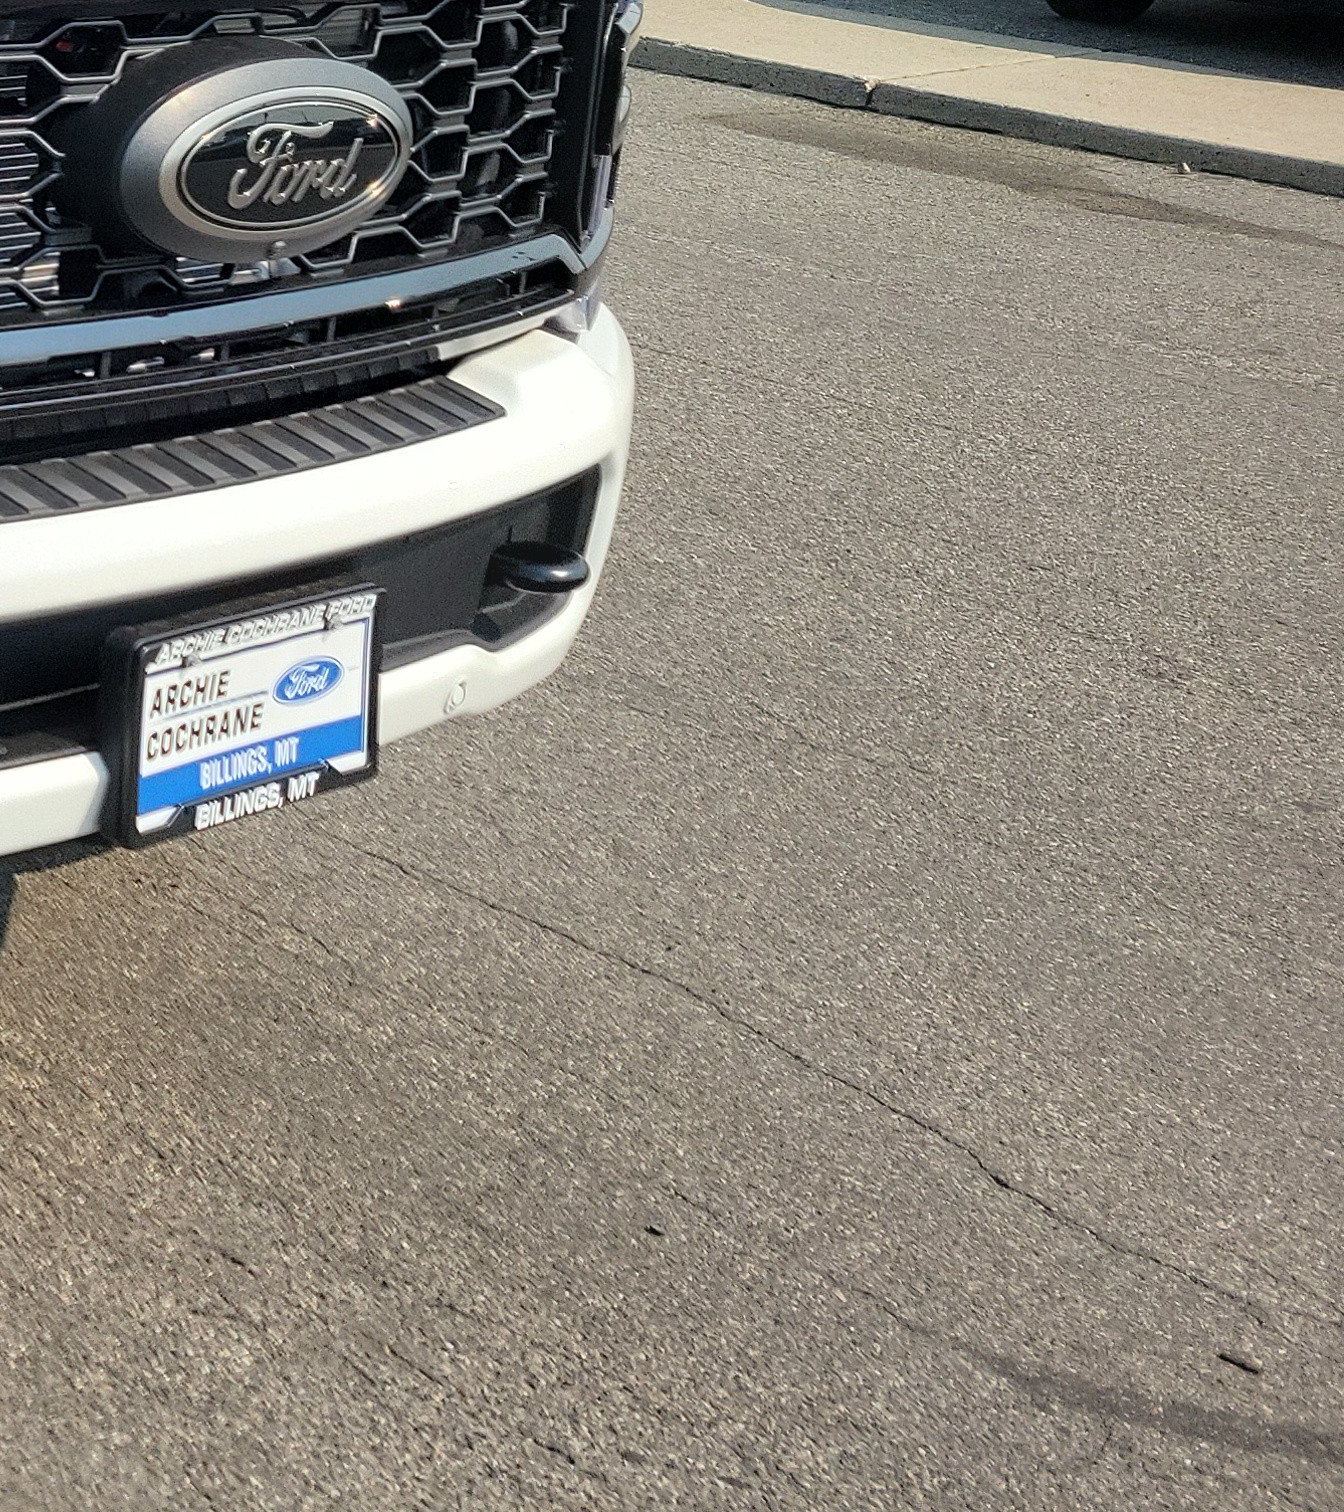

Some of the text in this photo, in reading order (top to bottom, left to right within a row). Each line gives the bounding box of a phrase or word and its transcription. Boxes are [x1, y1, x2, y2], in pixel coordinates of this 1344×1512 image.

[227, 121, 363, 210] Ford
[149, 669, 231, 720] ARCHIE
[285, 664, 330, 700] Ford
[145, 702, 264, 763] COCHRANE
[199, 738, 300, 790] BILLINGS, MT
[194, 771, 321, 832] BILLINGS, MT
